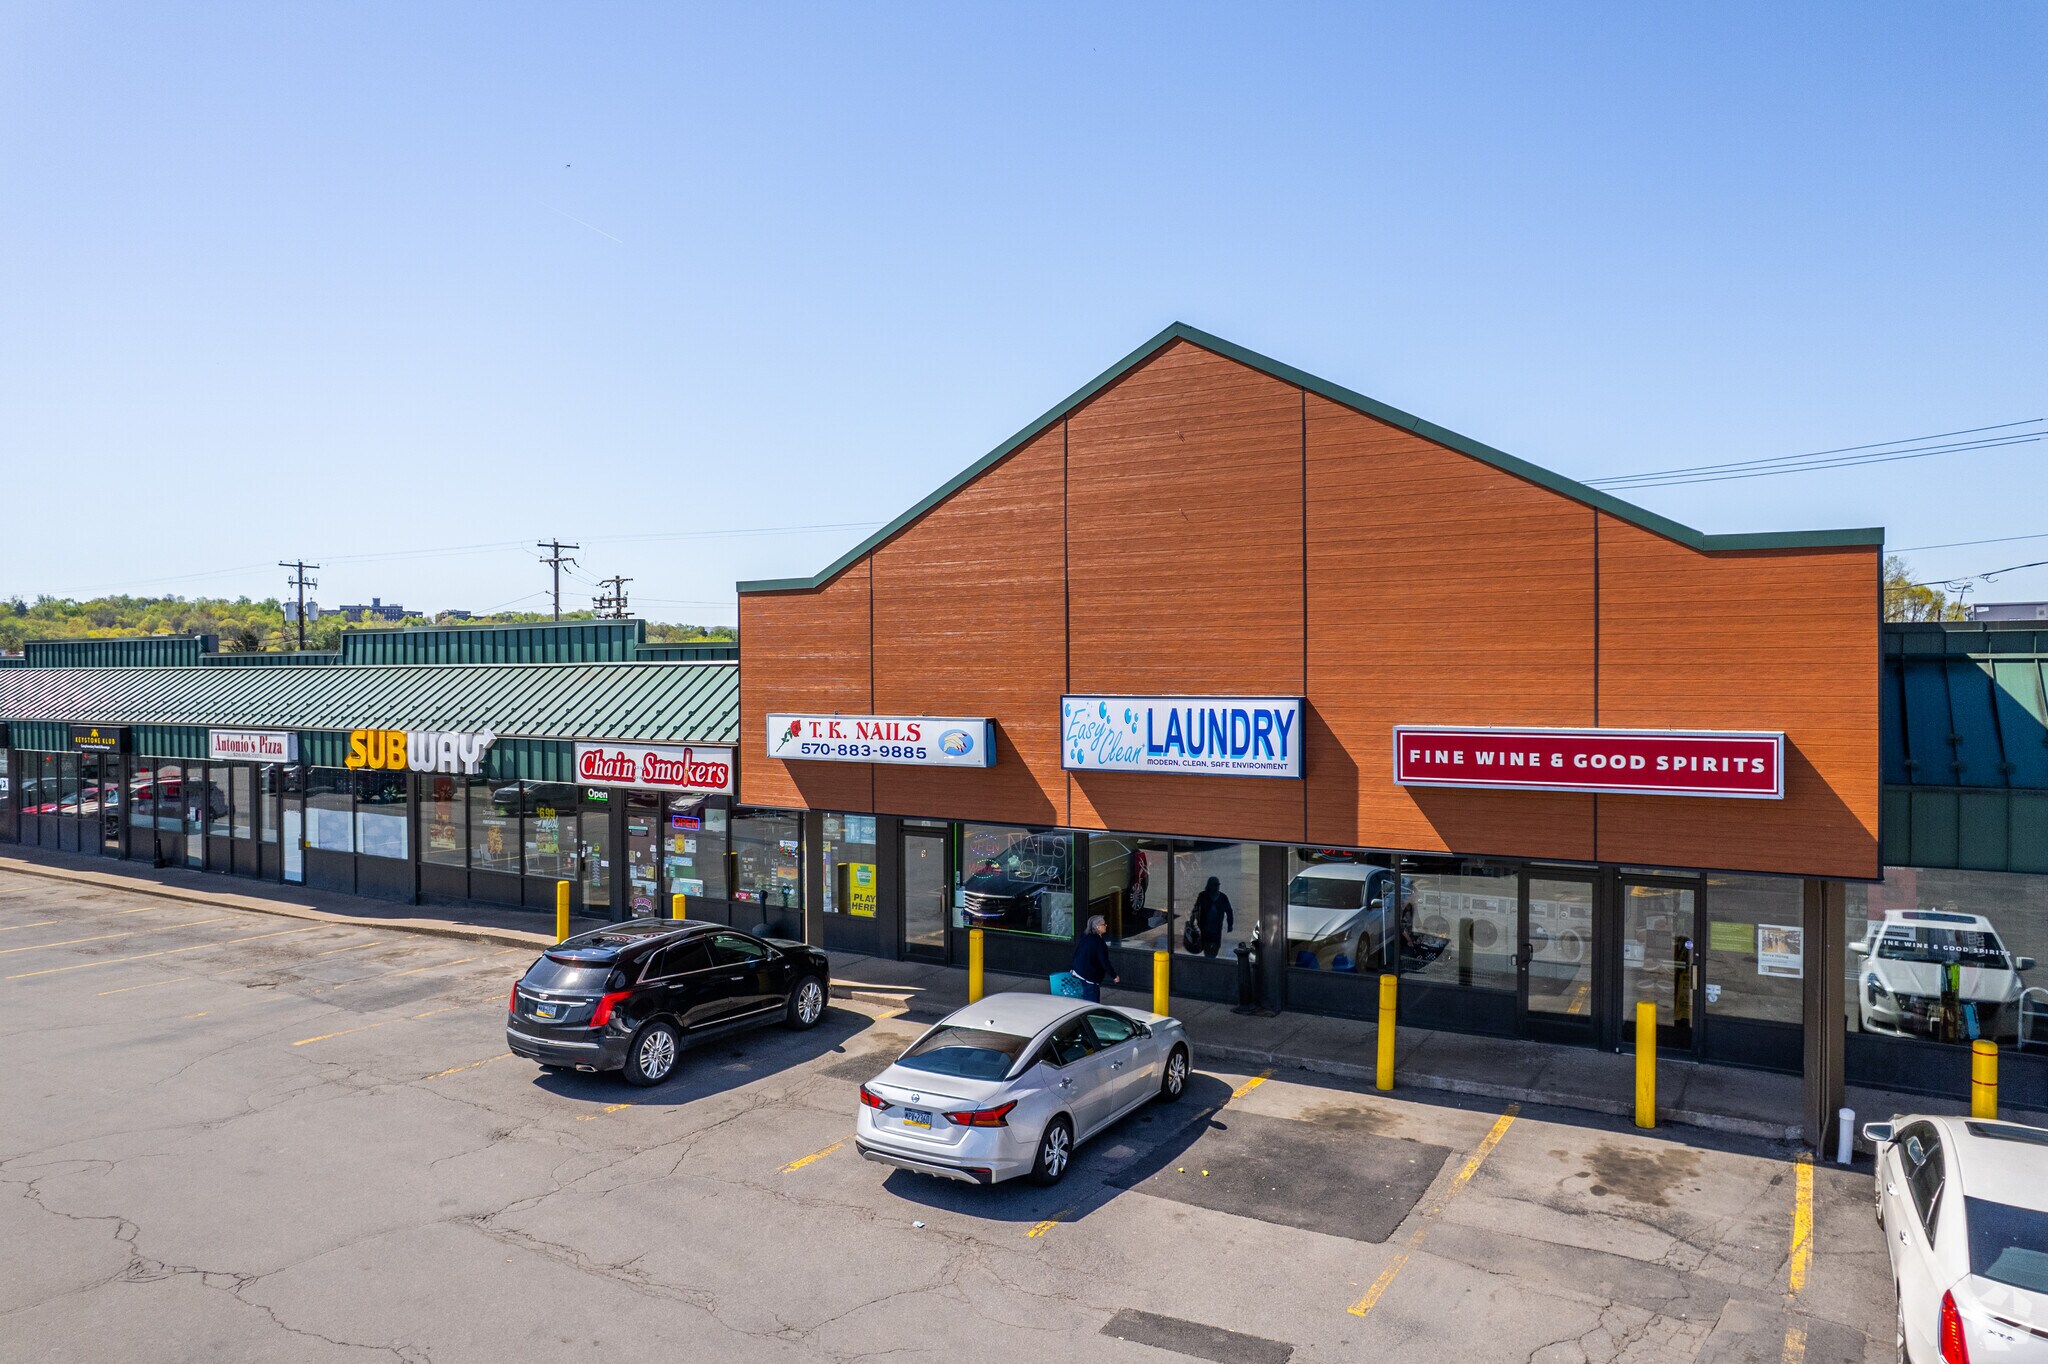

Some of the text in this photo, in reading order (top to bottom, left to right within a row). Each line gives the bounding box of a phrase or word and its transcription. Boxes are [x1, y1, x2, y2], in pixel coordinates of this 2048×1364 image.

[856, 721, 921, 742] NAILS
[1066, 708, 1106, 751] Easy
[1147, 708, 1295, 760] LAUNDRY
[215, 734, 283, 754] Antonio's Pizza
[344, 728, 497, 775] SUBWAY
[801, 743, 927, 759] 570-883-9885
[1099, 728, 1141, 765] Clean
[579, 748, 728, 788] Chain Smokers
[1210, 760, 1230, 768] SAFE
[1232, 761, 1288, 770] ENVIRONMENT
[1410, 749, 1765, 773] FINE WINE & GOOD SPIRITS
[588, 788, 608, 799] Open
[674, 817, 698, 828] OPEN
[1009, 833, 1066, 858] NAILS
[1017, 860, 1059, 882] Spa
[851, 902, 875, 912] HERE
[853, 893, 876, 903] PLAY
[1880, 939, 1899, 947] INE
[1904, 941, 1929, 949] WINE
[1973, 948, 2011, 957] SPIRITS
